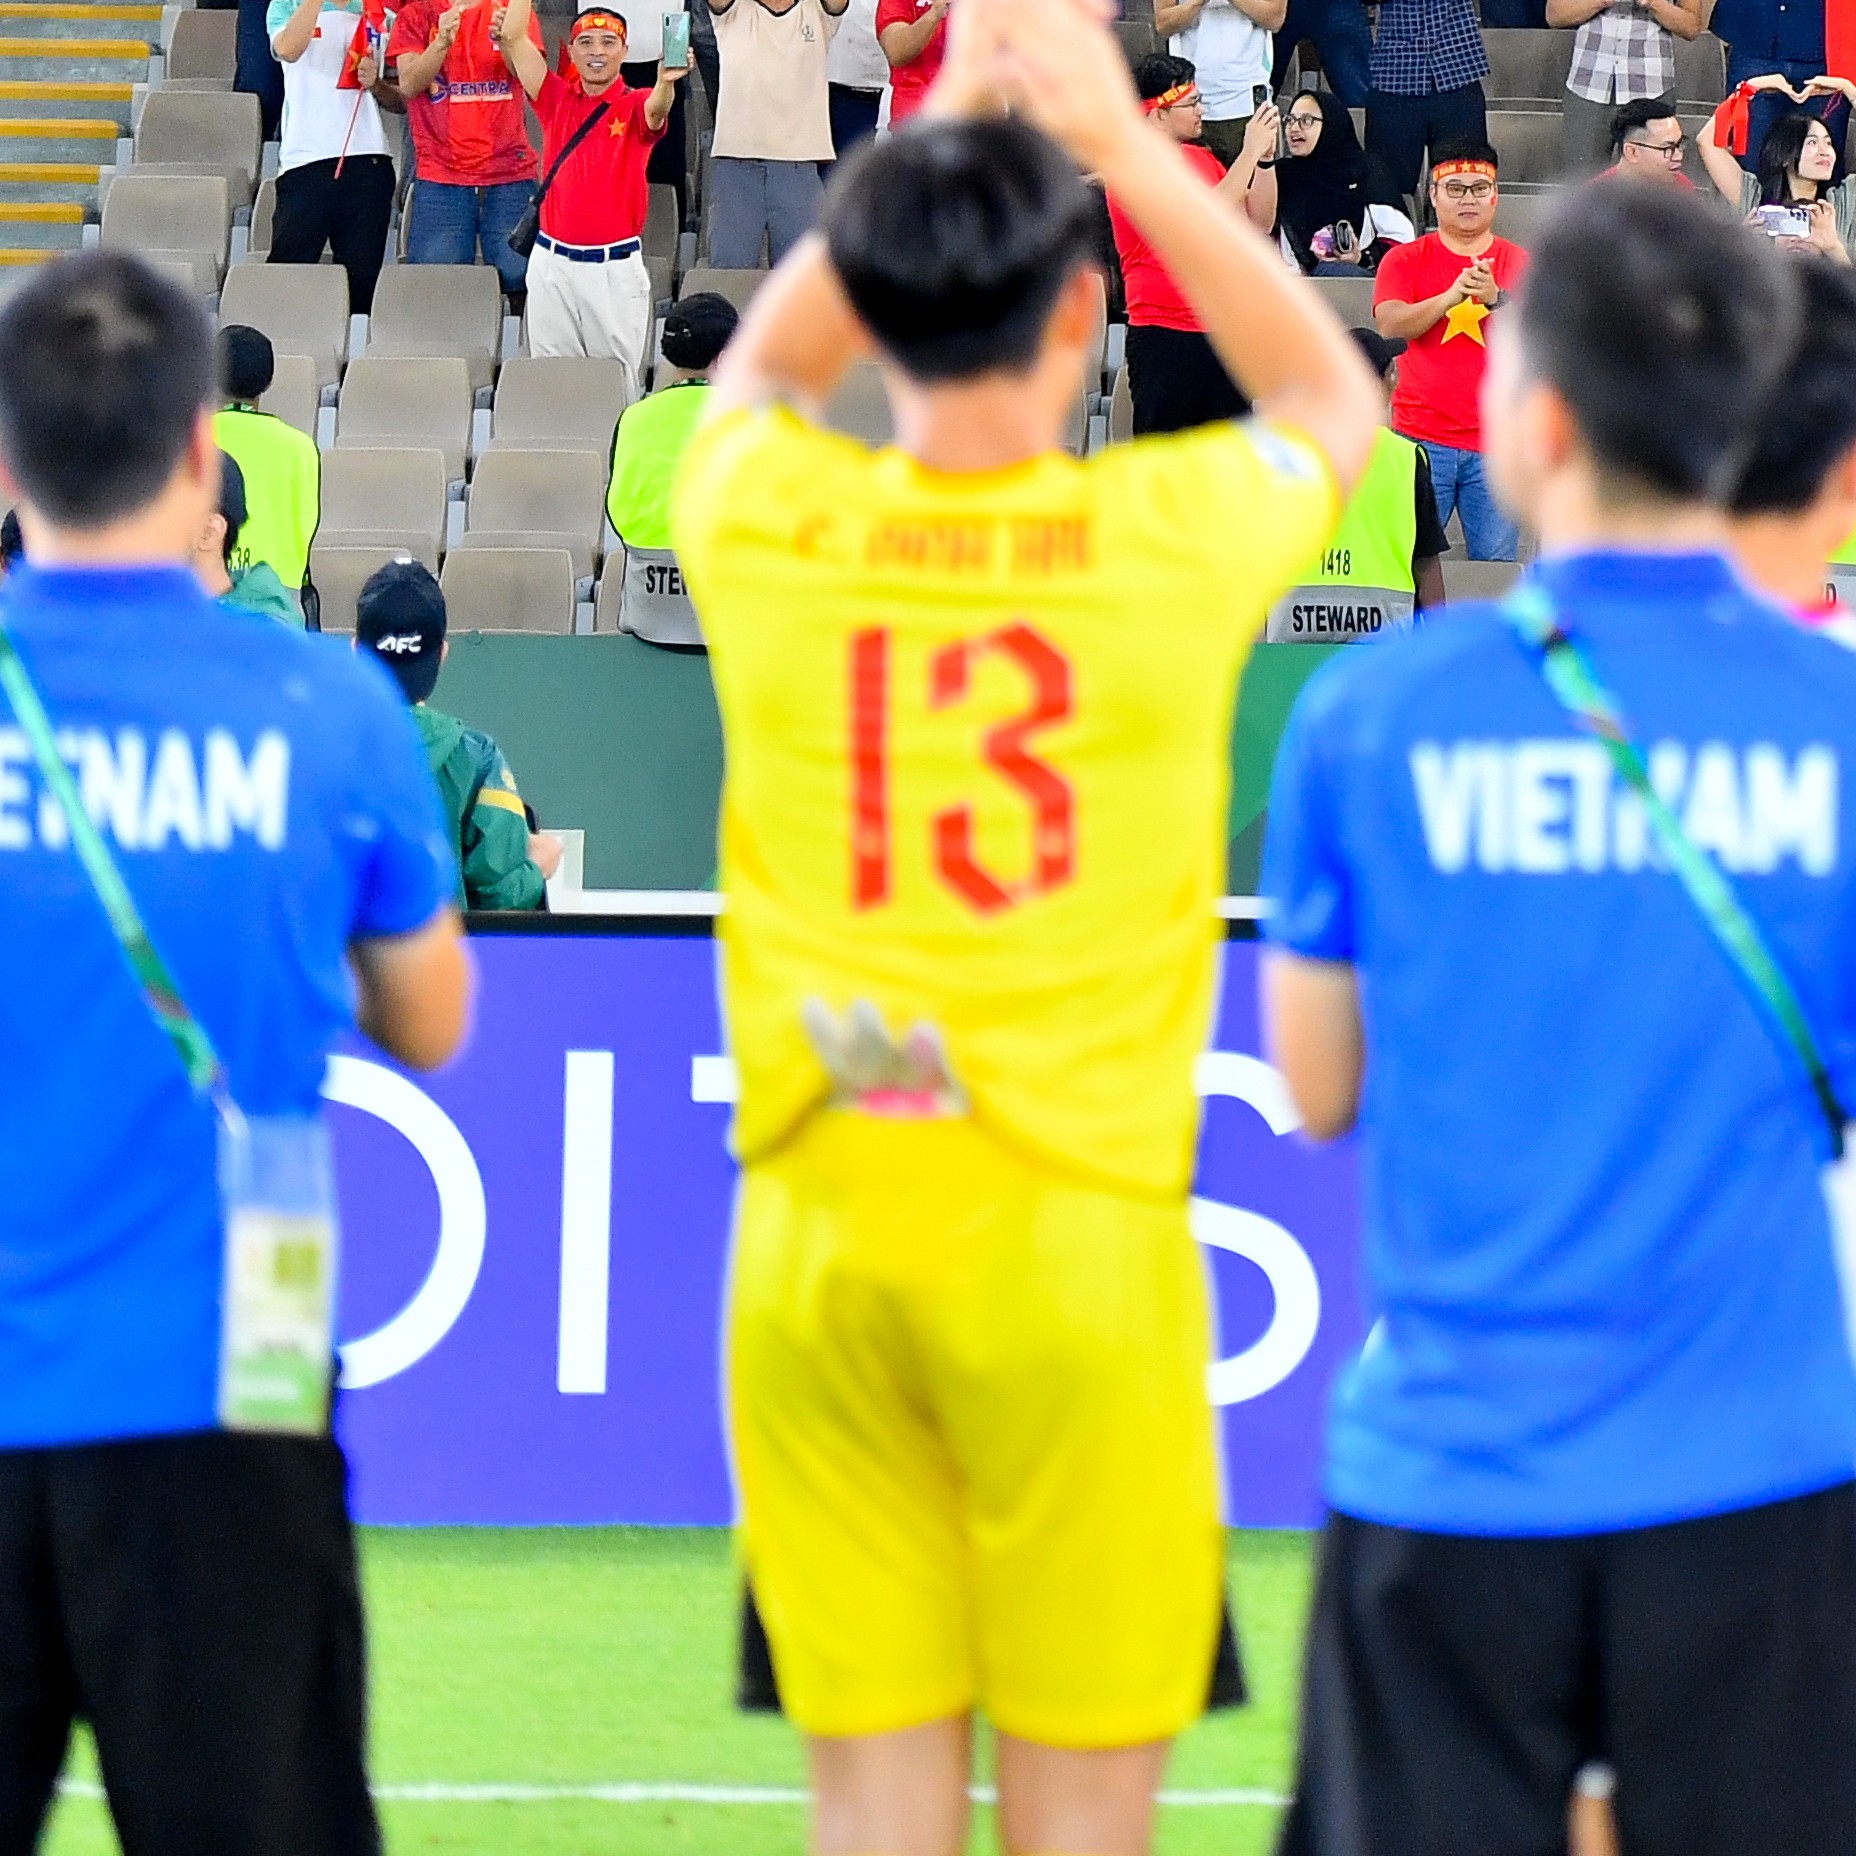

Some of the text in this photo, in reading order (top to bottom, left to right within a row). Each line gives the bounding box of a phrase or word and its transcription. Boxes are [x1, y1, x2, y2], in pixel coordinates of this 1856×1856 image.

[1291, 604, 1383, 634] STEWARD
[376, 633, 422, 655] AFC
[852, 624, 1078, 916] 13
